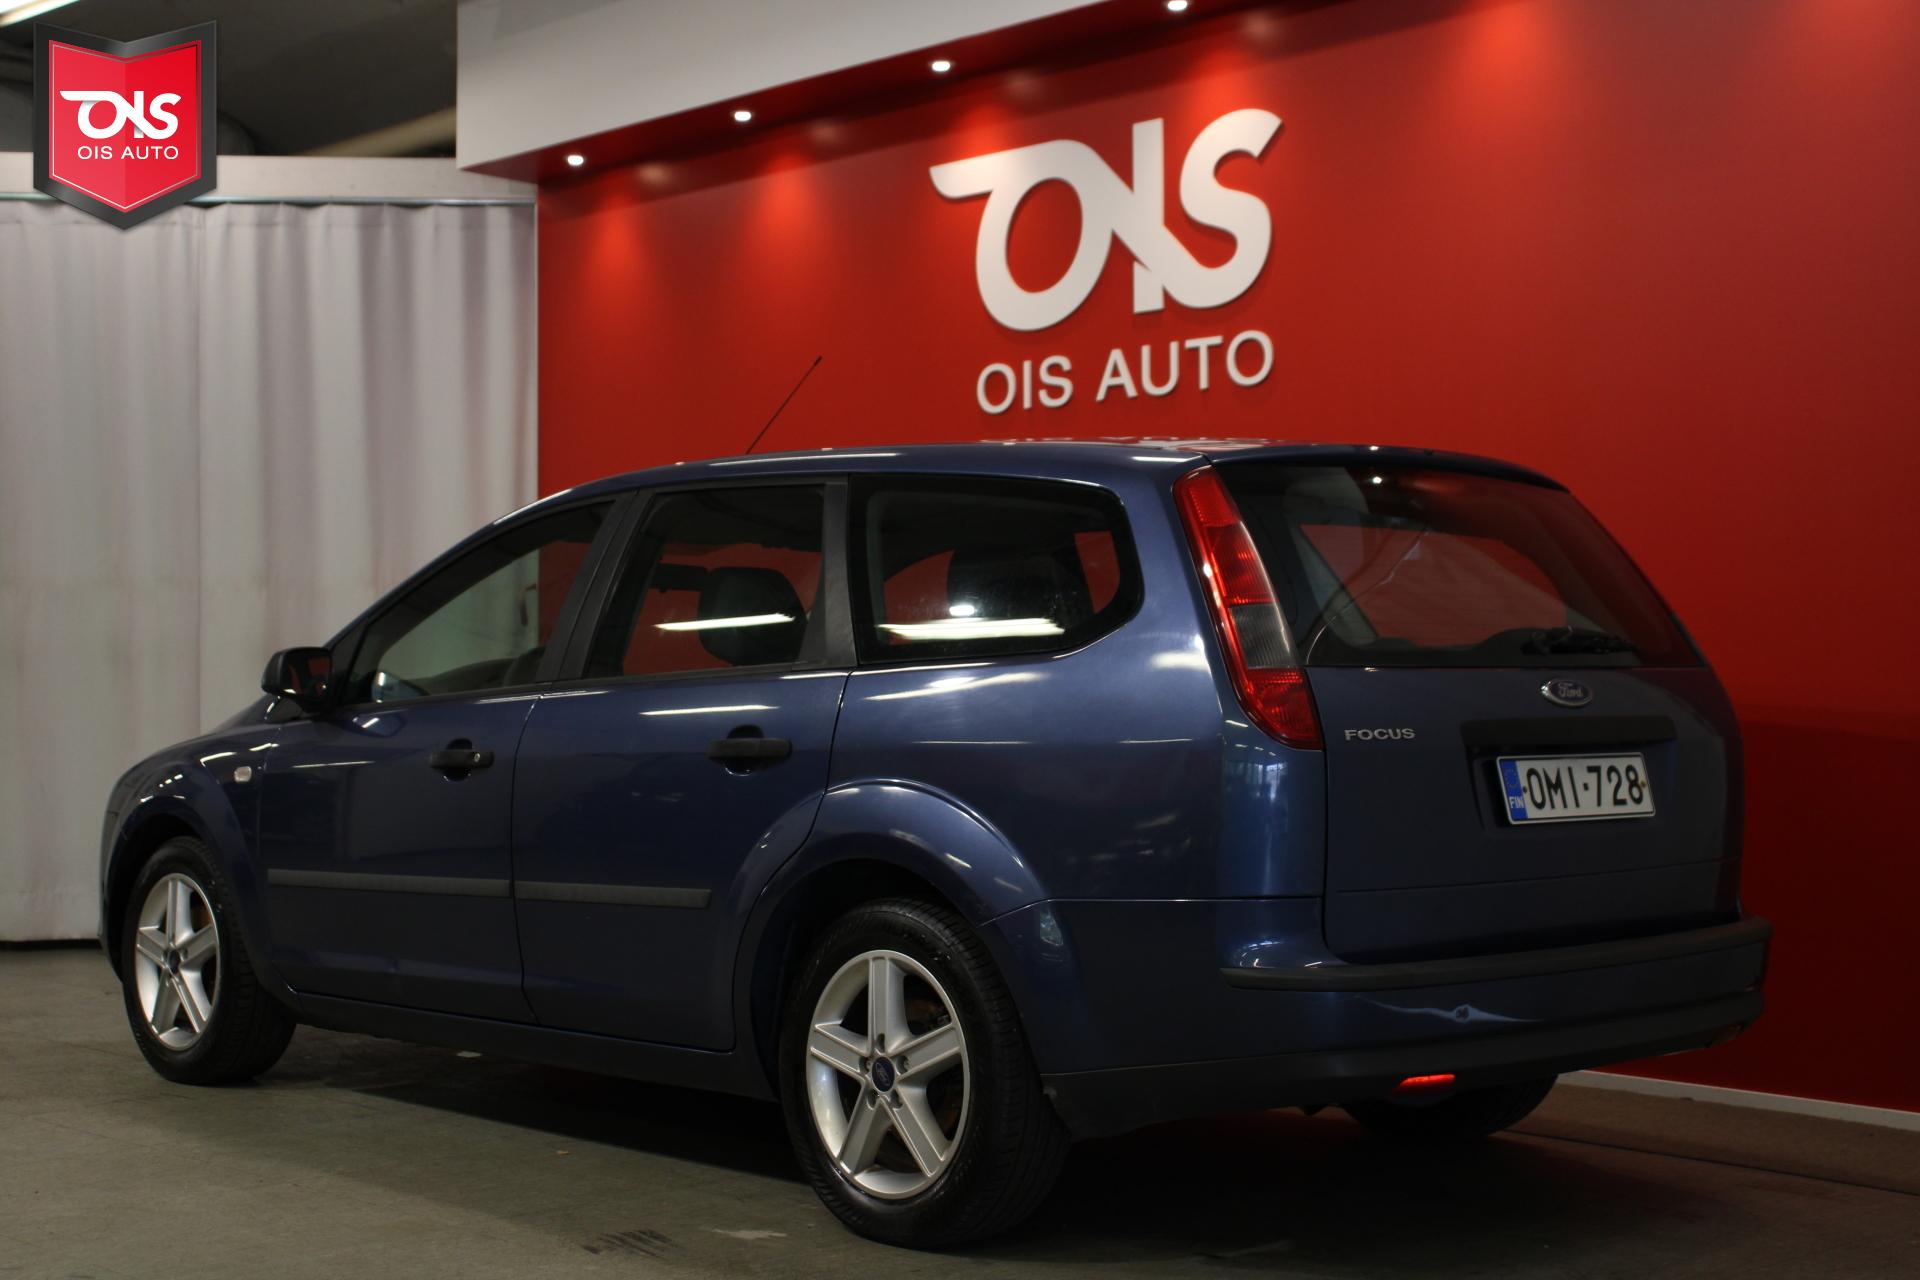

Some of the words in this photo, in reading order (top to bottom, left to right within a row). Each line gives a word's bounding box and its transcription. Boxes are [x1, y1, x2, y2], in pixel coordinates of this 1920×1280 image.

[929, 108, 1282, 331] OIS
[976, 356, 1073, 414] OIS
[1096, 330, 1274, 401] AUTO
[1344, 728, 1416, 741] FOCUS
[1508, 796, 1524, 810] FIN
[1526, 764, 1645, 810] OMI-728
